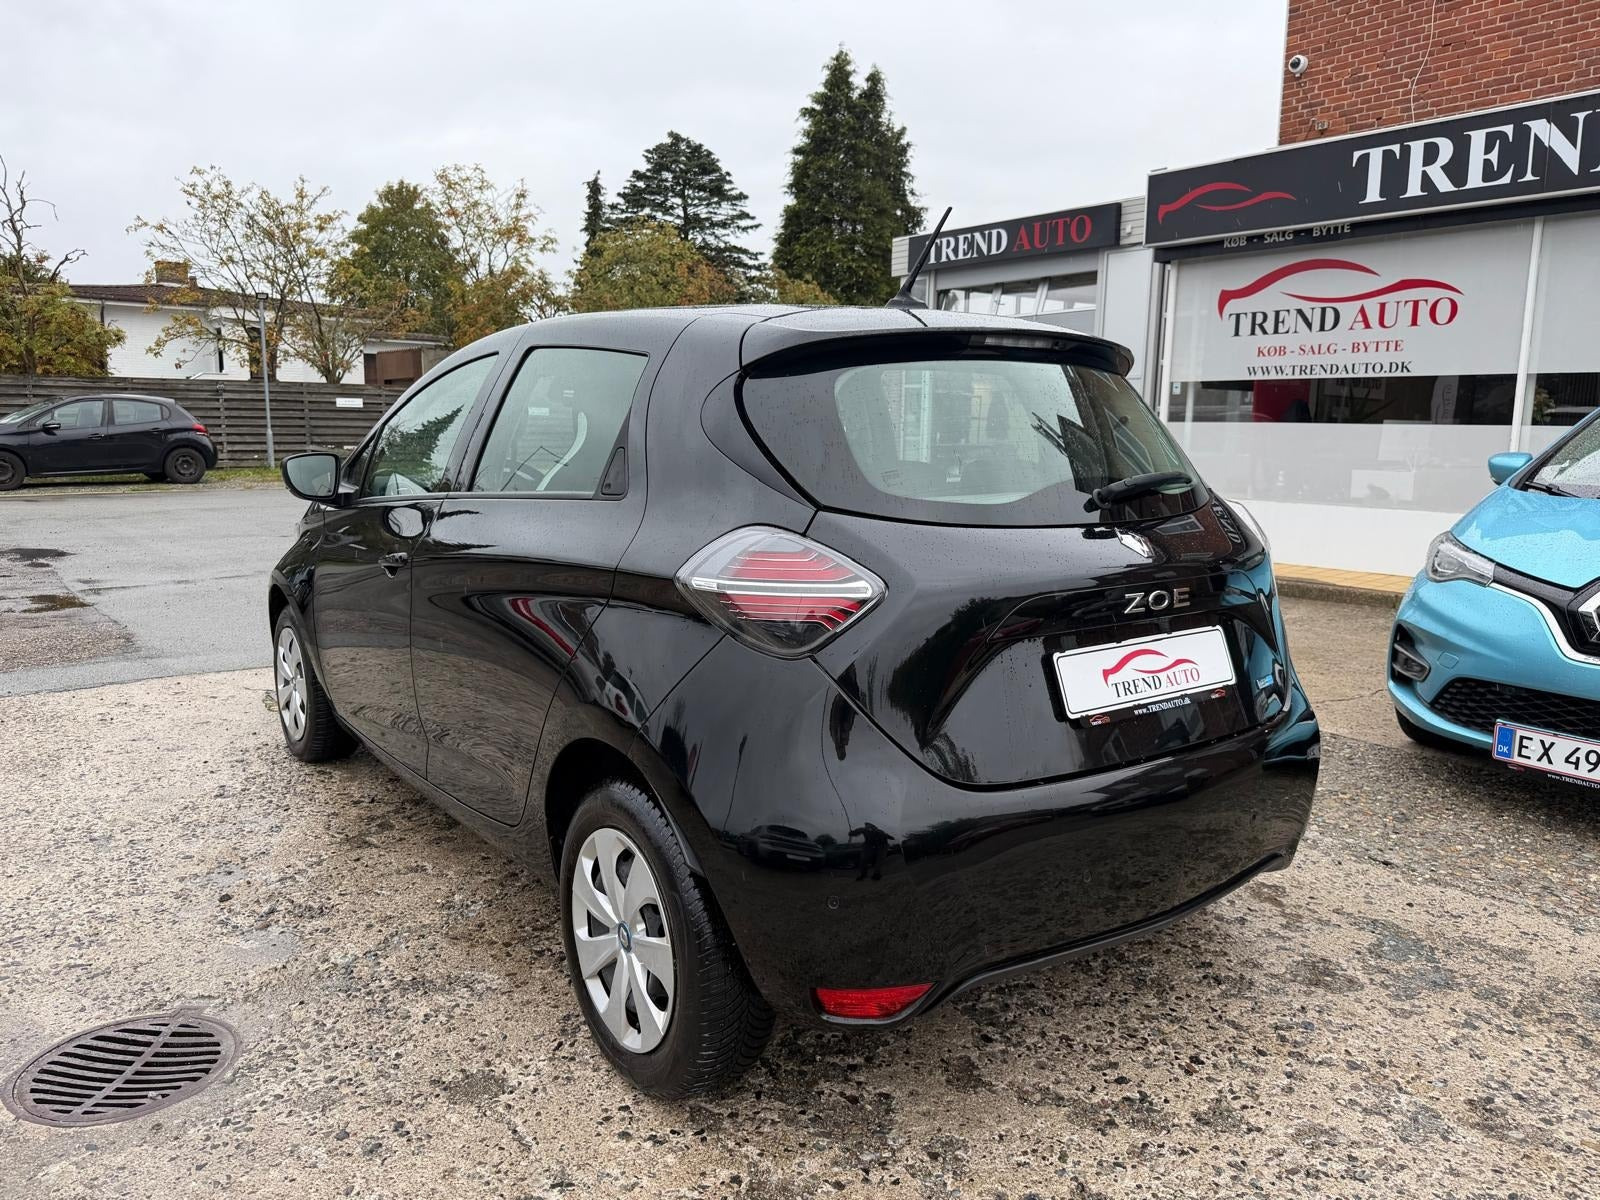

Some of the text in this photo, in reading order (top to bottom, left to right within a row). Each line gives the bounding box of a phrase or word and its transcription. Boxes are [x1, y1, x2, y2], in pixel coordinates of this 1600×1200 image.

[1352, 109, 1600, 205] TREN
[926, 214, 1092, 265] TREND AUTO
[1223, 235, 1247, 248] KØB
[1263, 230, 1293, 244] SALG
[1312, 223, 1351, 237] BYTTE
[1228, 296, 1459, 338] TREND AUTO
[1256, 344, 1287, 358] KØB
[1298, 342, 1338, 357] SALG
[1351, 339, 1404, 354] BYTTE
[1247, 360, 1413, 377] WWW.TRENDAUTO.DK
[1124, 587, 1191, 615] ZOE
[1112, 667, 1201, 699] TREND AUTO
[1133, 697, 1192, 716] www.TRENDAUTO.dk
[1497, 744, 1509, 754] DK
[1517, 734, 1600, 773] EX 49
